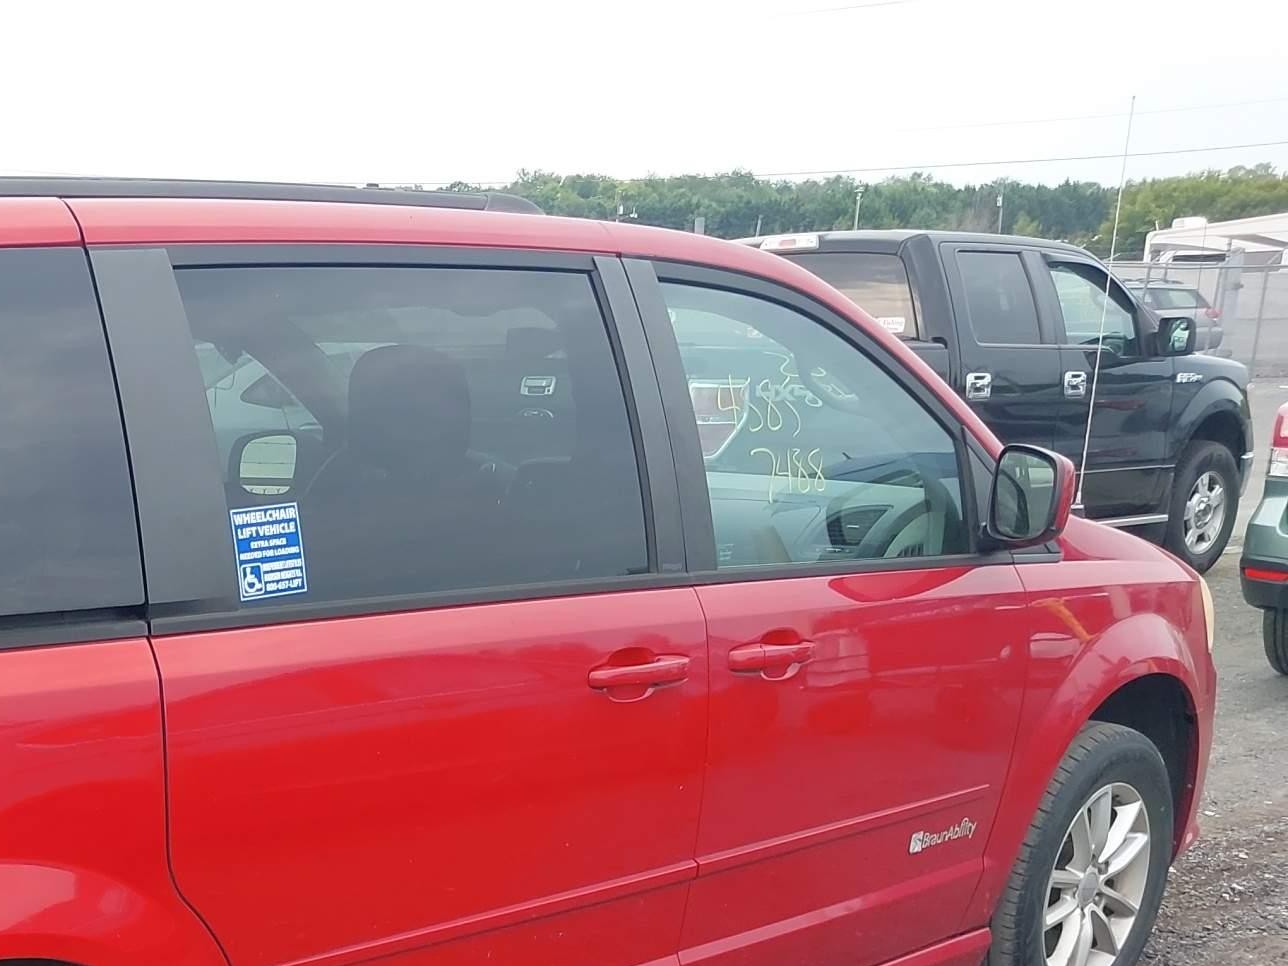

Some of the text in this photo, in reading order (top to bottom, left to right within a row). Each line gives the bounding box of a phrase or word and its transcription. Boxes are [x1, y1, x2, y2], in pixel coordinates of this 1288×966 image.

[750, 447, 826, 505] 7488
[233, 508, 296, 525] WHEELCHAIR
[238, 522, 296, 540] LIFT VEHICLE
[250, 541, 269, 549] EXTRA
[275, 546, 299, 555] LOADING
[922, 817, 977, 849] BraunAbility
